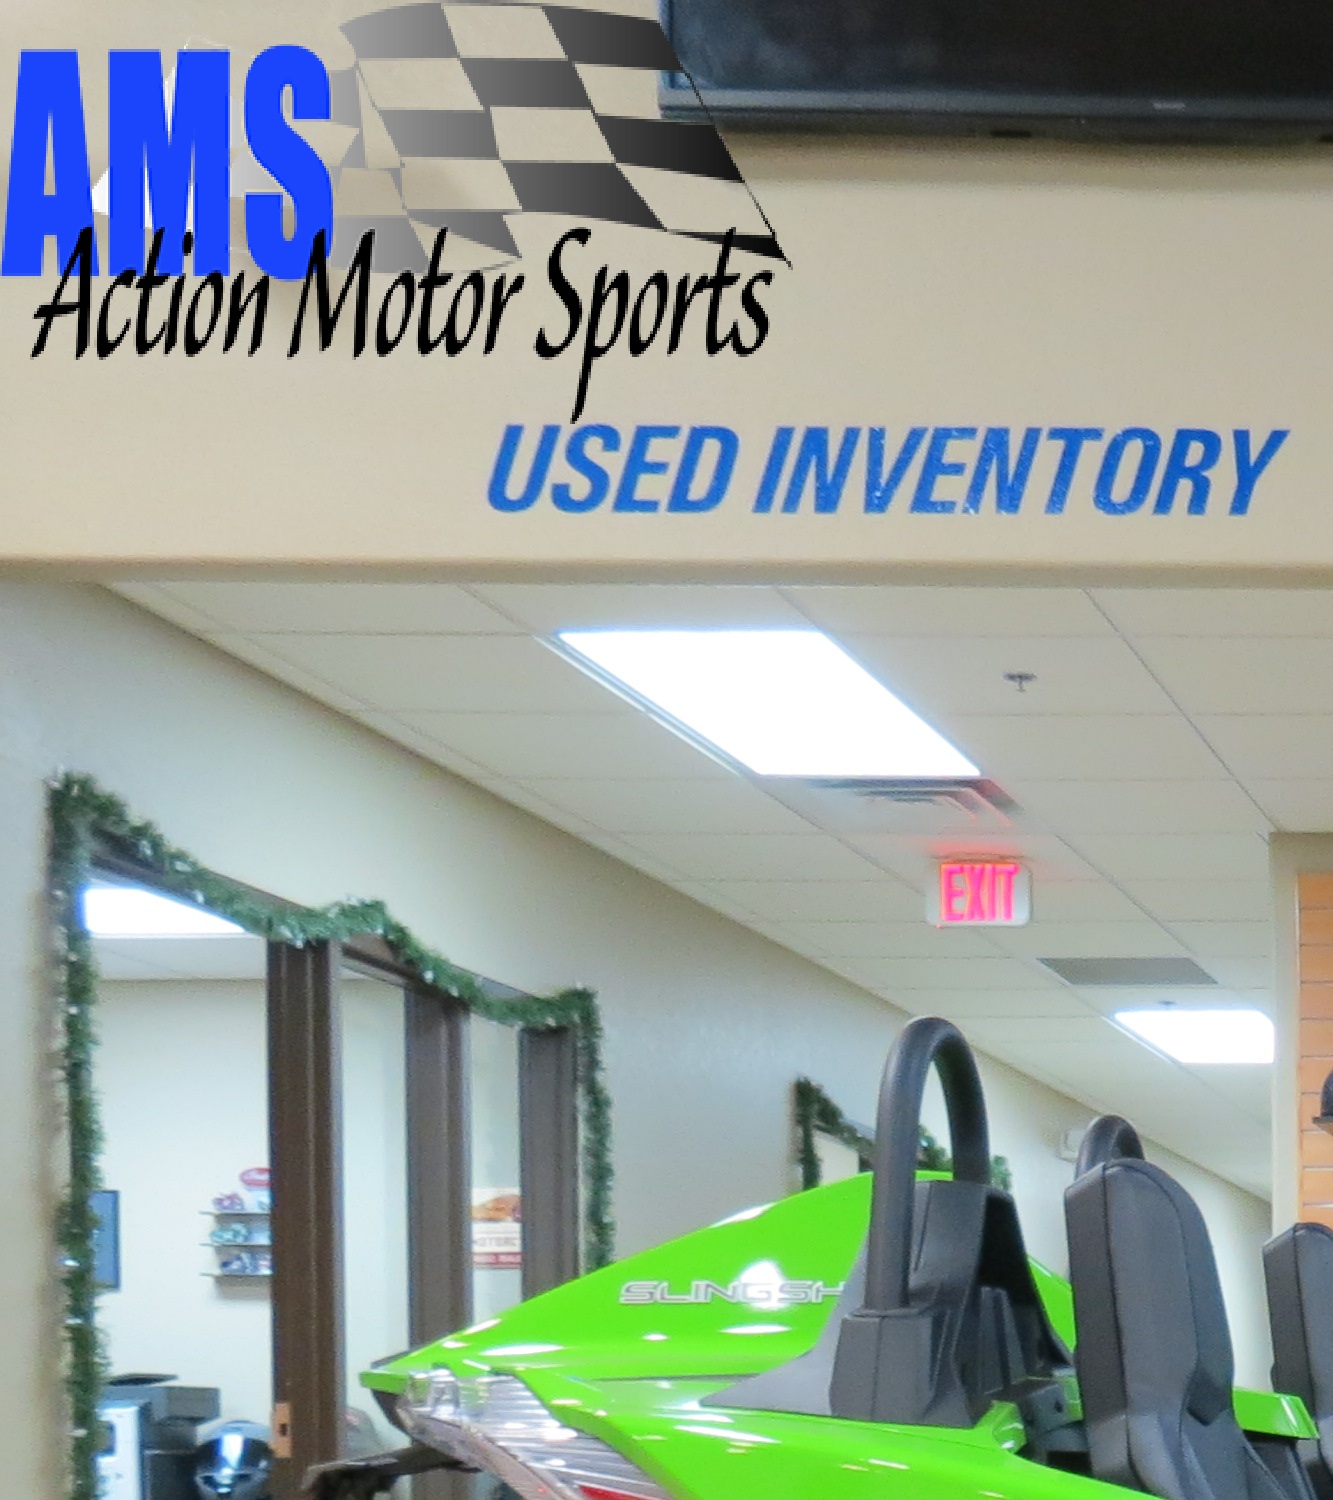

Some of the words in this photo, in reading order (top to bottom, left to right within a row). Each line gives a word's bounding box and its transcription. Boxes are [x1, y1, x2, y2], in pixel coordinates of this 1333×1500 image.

[486, 425, 737, 513] USED
[753, 427, 1290, 517] INVENTORY
[938, 862, 1020, 922] EXIT
[619, 1280, 846, 1304] SLINGSH
